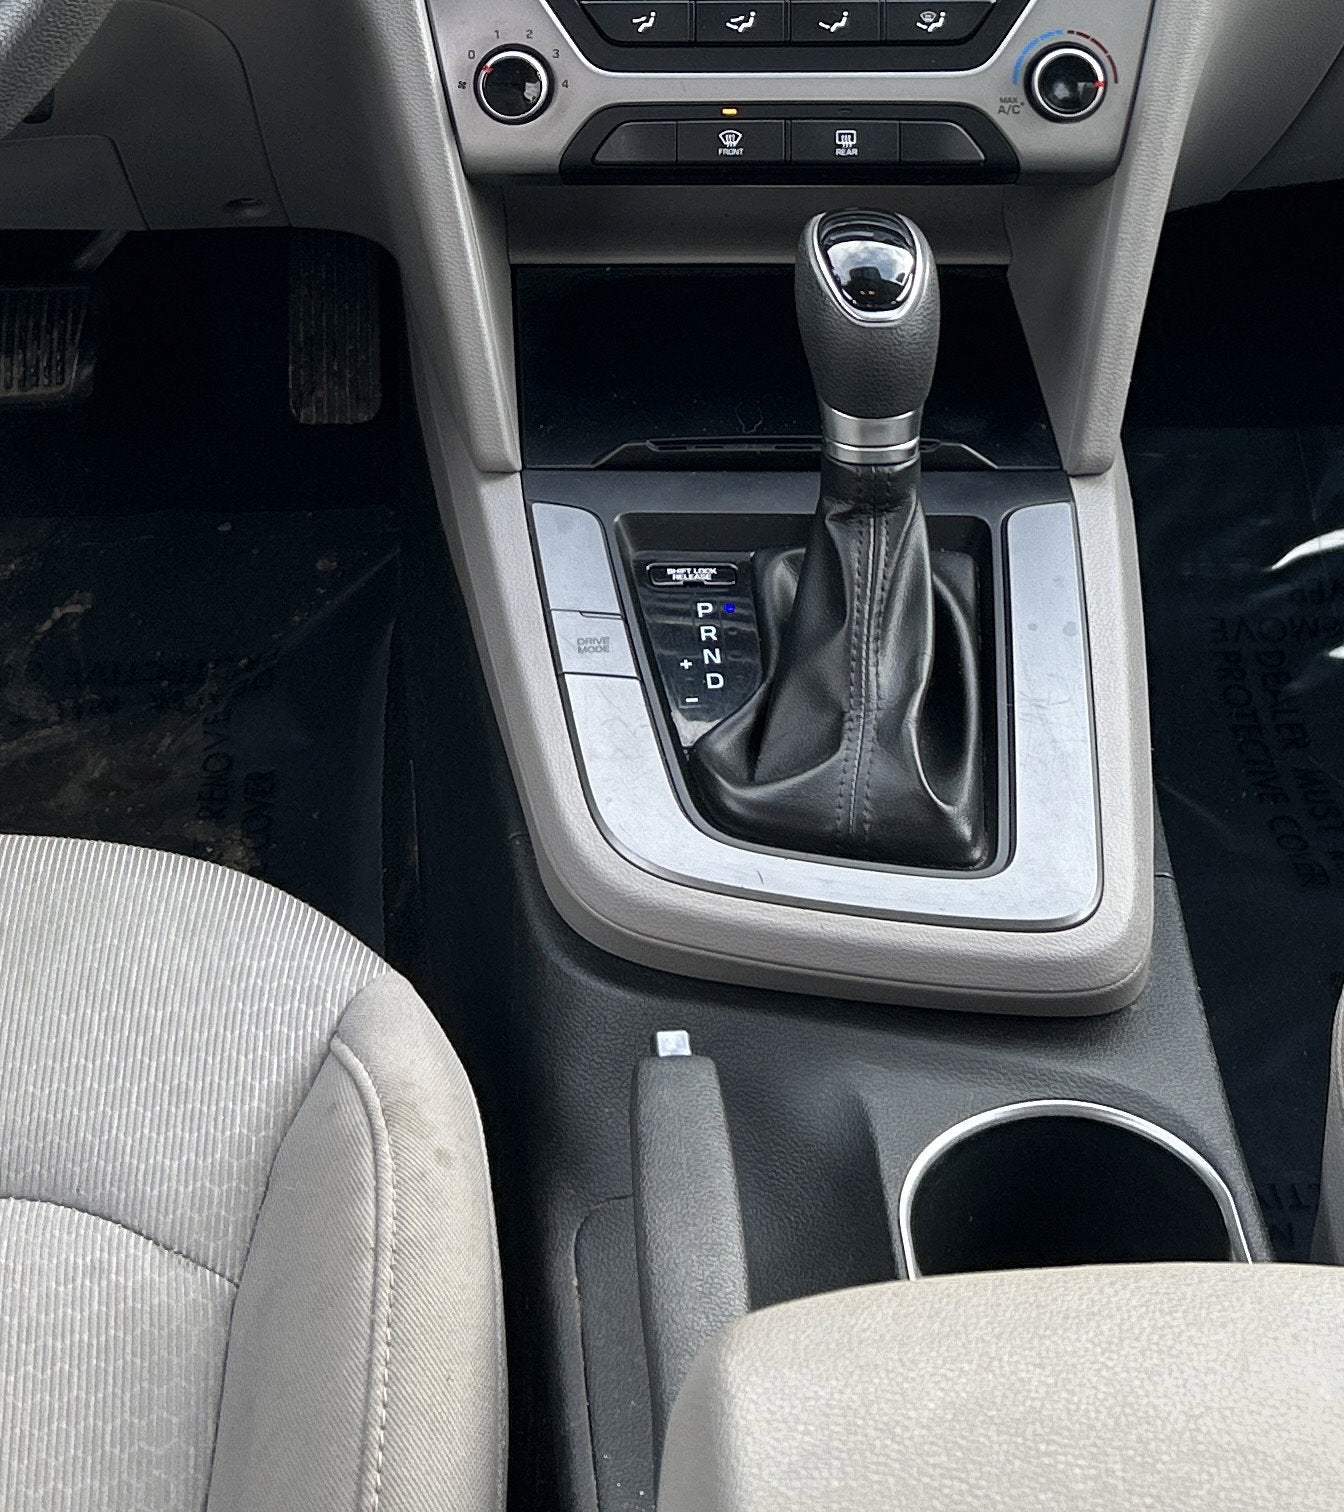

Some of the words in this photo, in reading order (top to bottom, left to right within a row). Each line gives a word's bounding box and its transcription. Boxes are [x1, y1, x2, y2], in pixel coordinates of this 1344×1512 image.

[526, 29, 534, 39] 2
[552, 49, 560, 59] 3
[561, 79, 569, 89] 4
[999, 96, 1018, 104] MAX
[997, 104, 1021, 115] A/C
[718, 148, 744, 156] FRONT
[835, 148, 858, 156] REAR
[693, 567, 718, 575] LOCK
[672, 573, 713, 581] RELEASE
[696, 602, 713, 618] P
[699, 625, 718, 642] R
[577, 636, 610, 646] DRIVE
[577, 645, 610, 655] MODE
[702, 648, 722, 665] N
[706, 672, 725, 689] D
